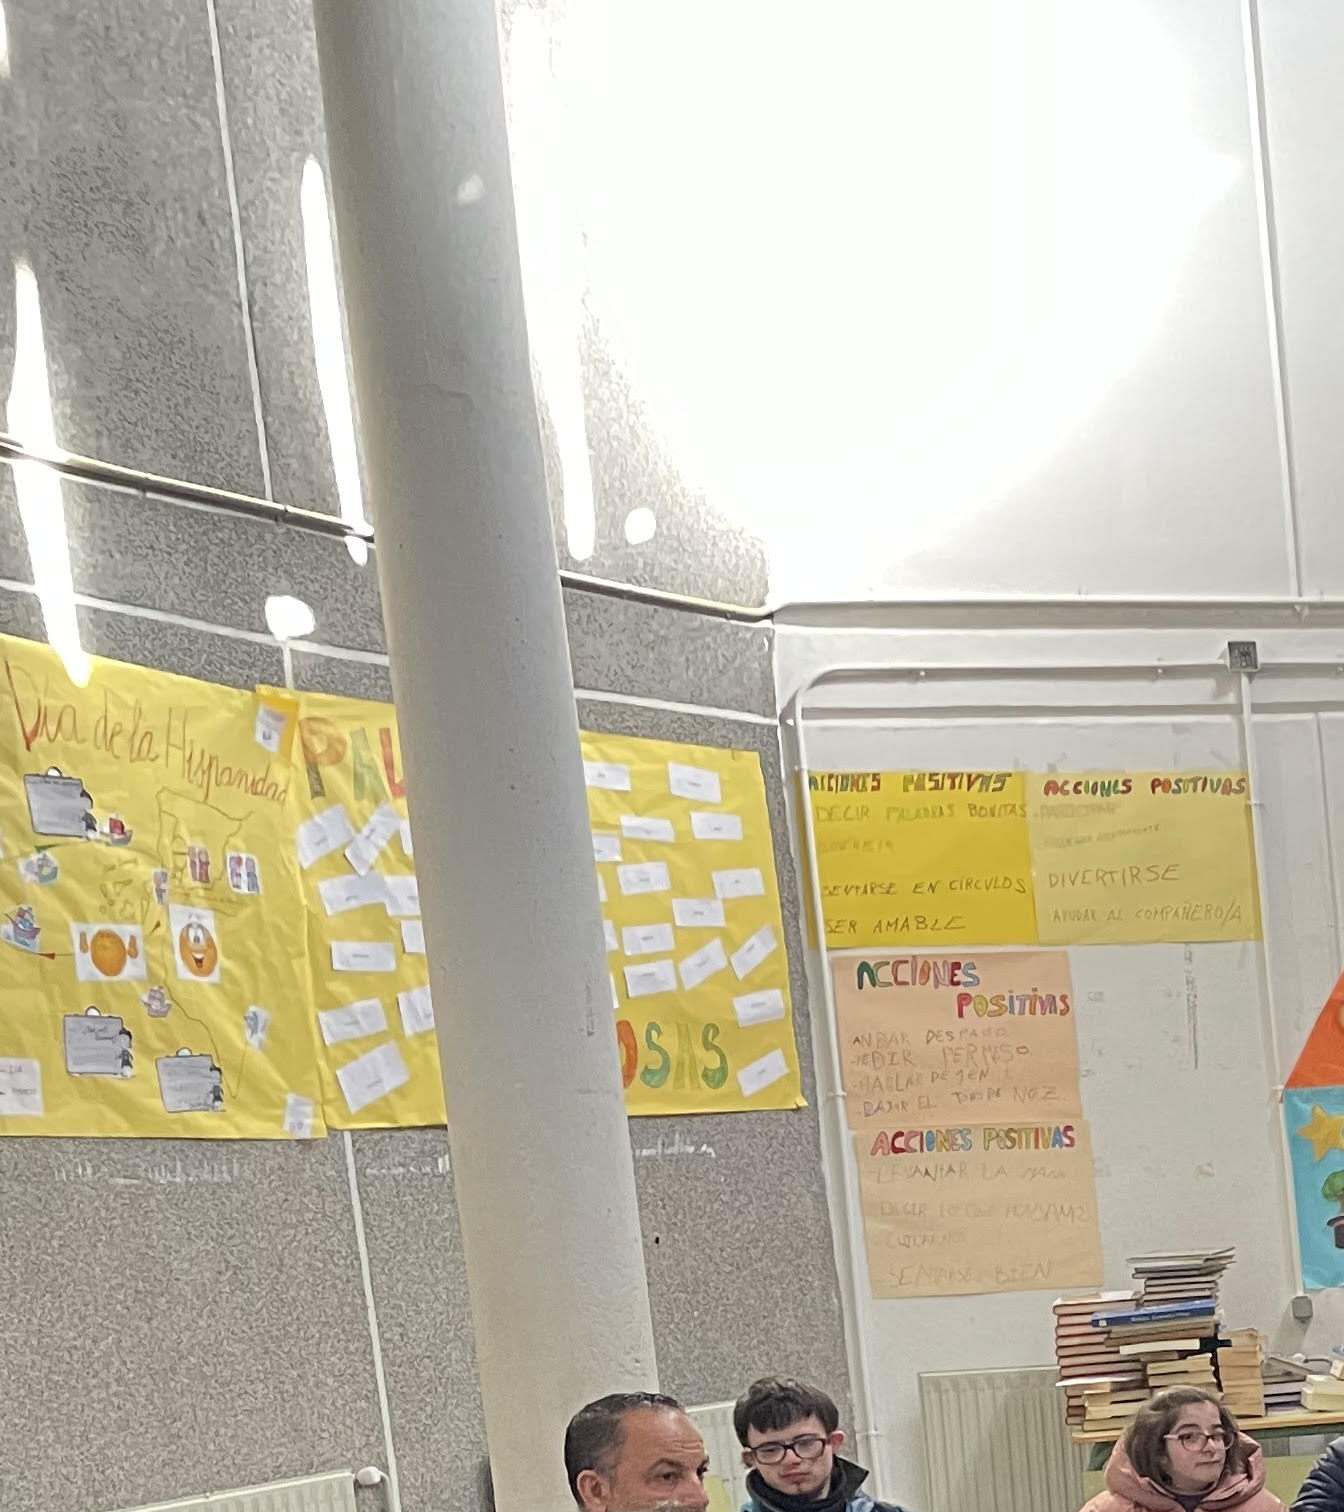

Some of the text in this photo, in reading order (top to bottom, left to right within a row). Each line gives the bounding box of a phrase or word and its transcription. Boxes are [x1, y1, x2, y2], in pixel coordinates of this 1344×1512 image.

[297, 715, 409, 803] PAL
[1043, 776, 1247, 797] ACCIONES POSITIVAS
[912, 880, 942, 895] EN
[1048, 863, 1181, 889] DIVERTIRSE
[872, 915, 967, 935] AMABLE
[857, 956, 981, 990] ACCIONES
[615, 1019, 729, 1091] OSAS
[869, 1125, 1077, 1157] ACCIONES POSITIVAS
